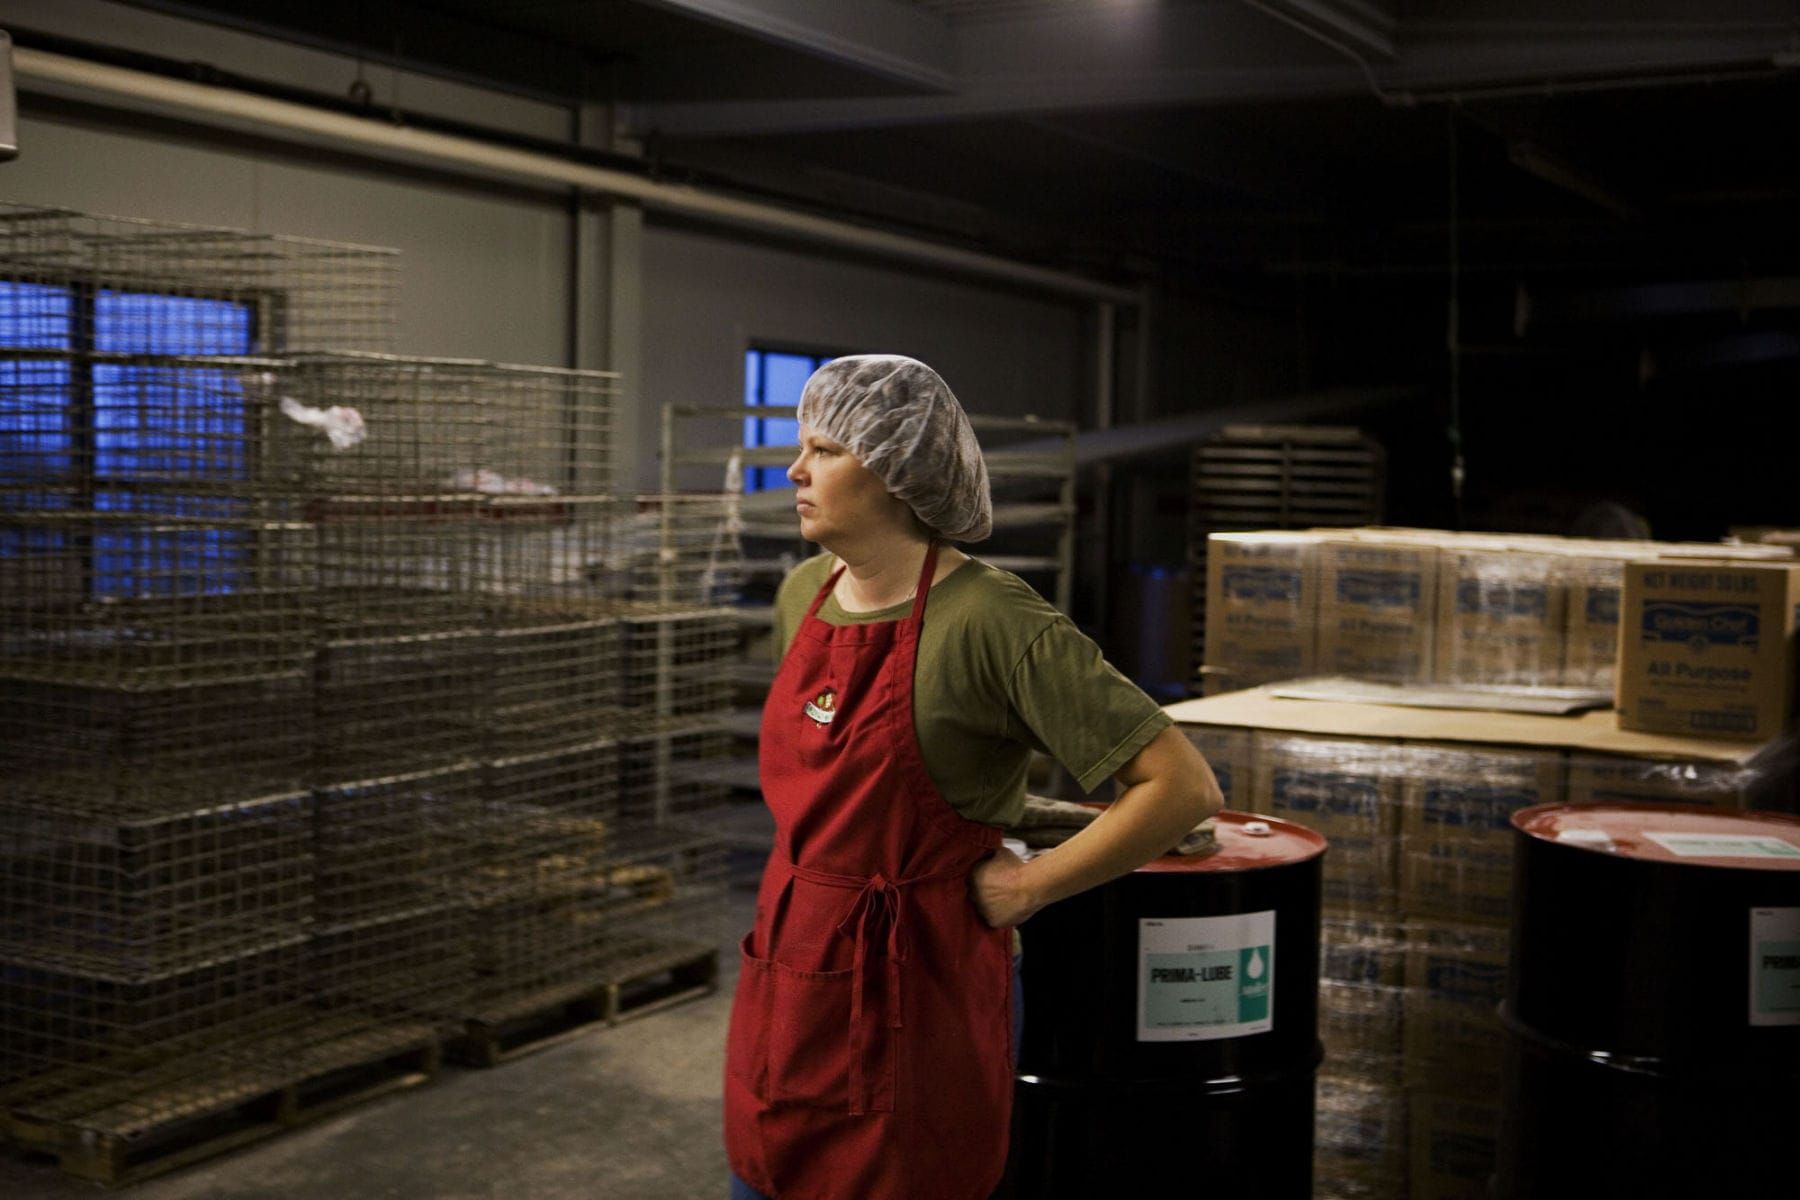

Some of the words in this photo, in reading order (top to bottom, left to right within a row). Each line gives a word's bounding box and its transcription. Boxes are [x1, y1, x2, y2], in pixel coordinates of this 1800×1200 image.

[1648, 661, 1671, 675] All
[1676, 662, 1753, 679] Purpose
[1150, 965, 1234, 984] PRIMA-LUBE
